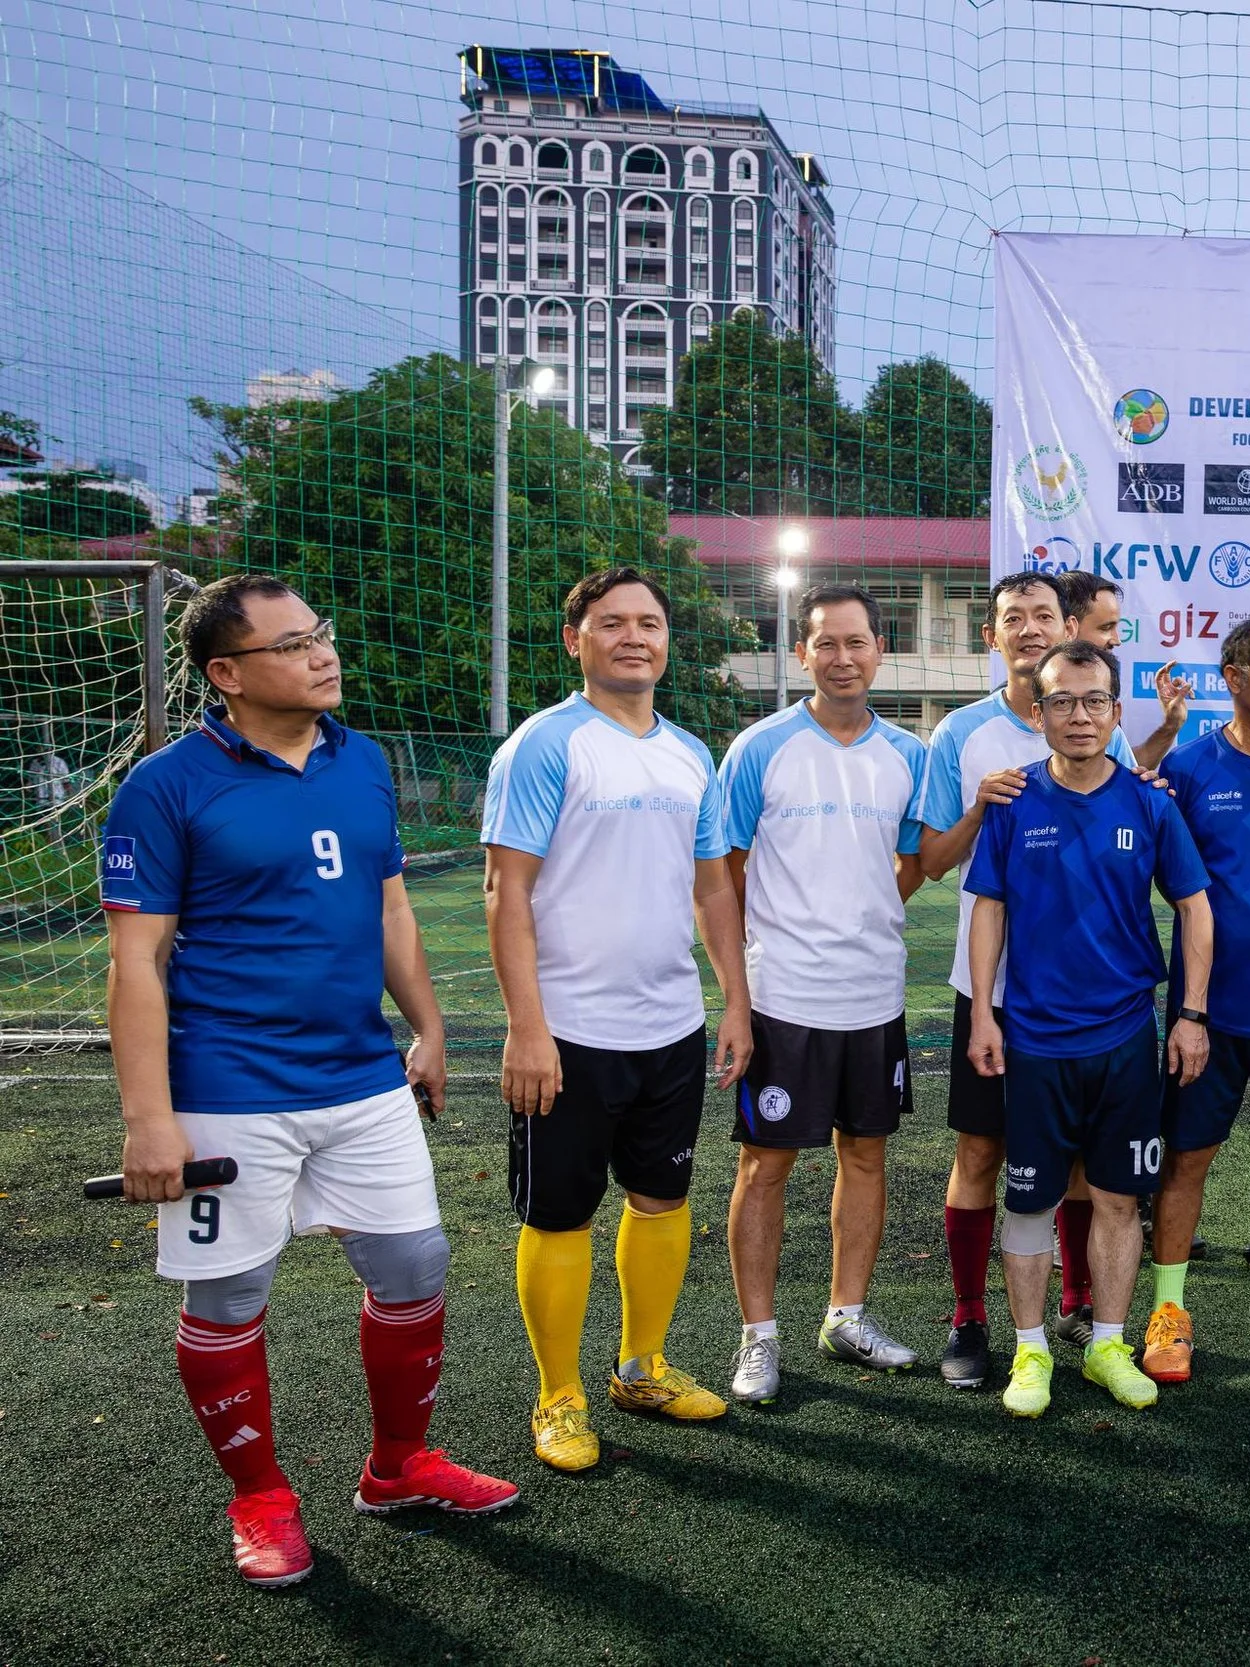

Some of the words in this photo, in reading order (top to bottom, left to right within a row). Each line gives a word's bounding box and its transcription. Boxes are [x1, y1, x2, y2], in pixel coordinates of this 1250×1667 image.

[1120, 483, 1182, 502] ADB
[1208, 496, 1236, 506] WORLD
[1158, 602, 1219, 648] giz
[583, 796, 628, 812] unicef
[1208, 790, 1233, 801] unicef
[780, 802, 821, 819] unicef
[1024, 826, 1049, 837] unicef
[1117, 828, 1134, 850] 10
[311, 829, 344, 880] 9
[1128, 1137, 1162, 1176] 10
[187, 1194, 221, 1245] 9
[200, 1389, 253, 1417] LFC
